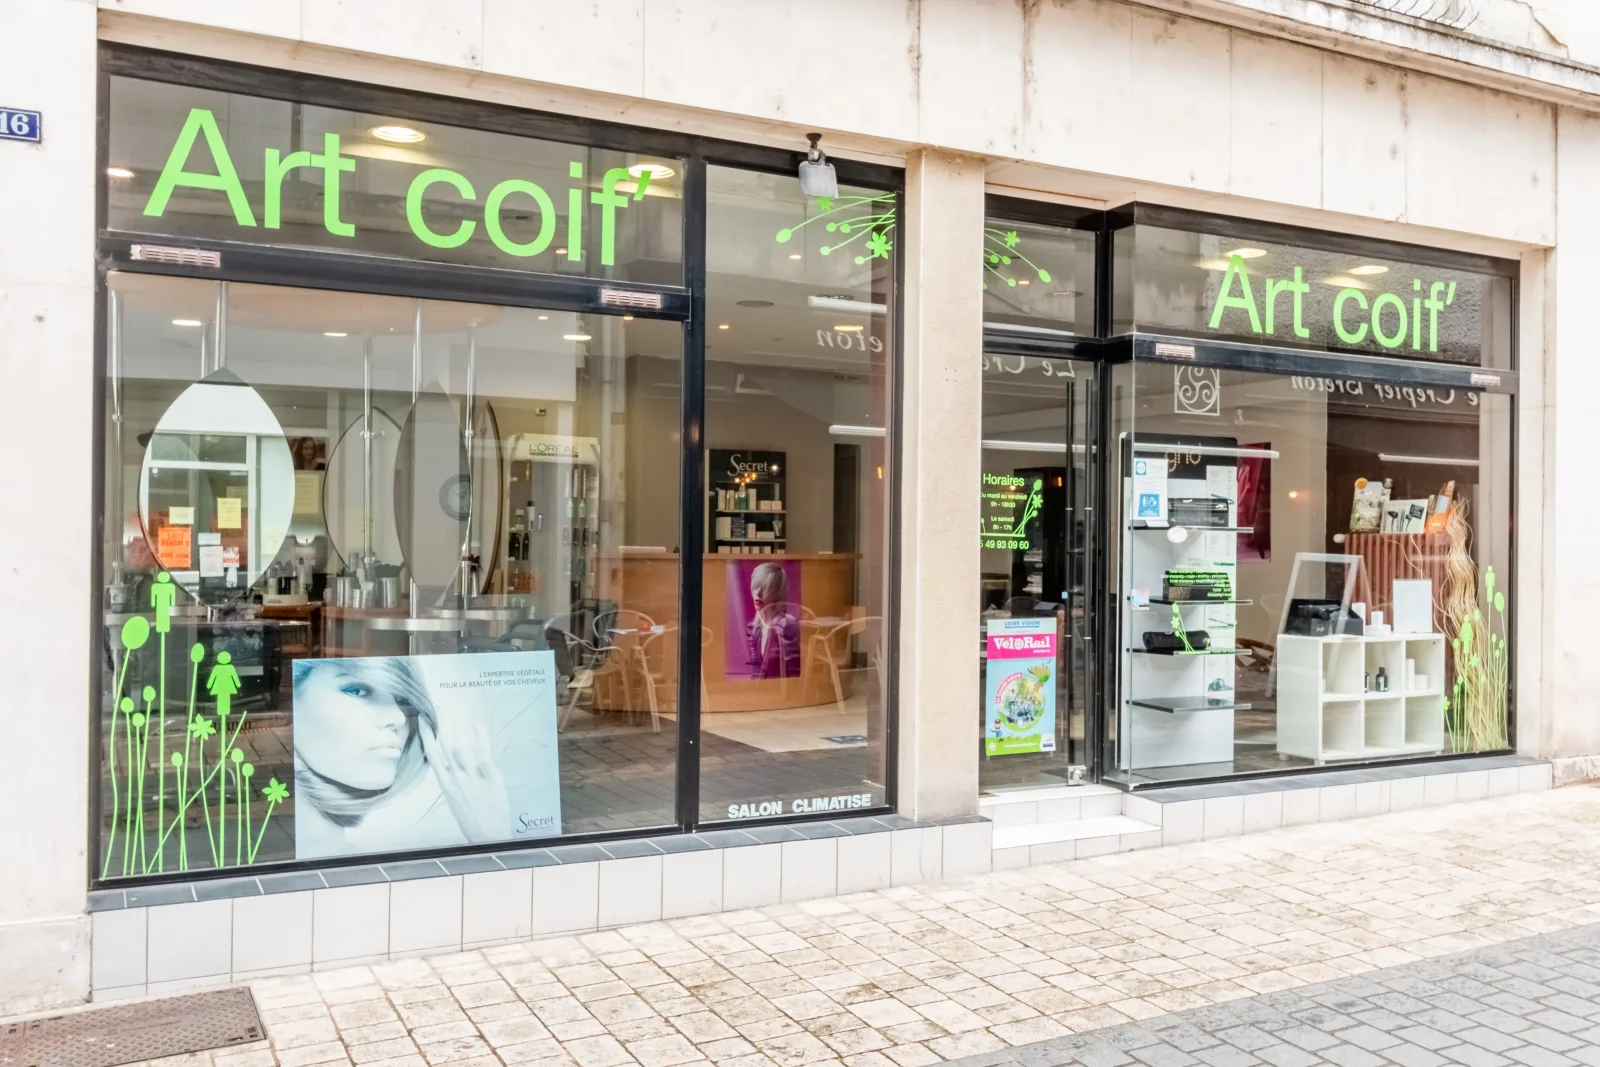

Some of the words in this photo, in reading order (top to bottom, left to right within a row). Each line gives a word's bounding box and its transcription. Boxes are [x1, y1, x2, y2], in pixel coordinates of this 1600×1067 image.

[0, 111, 30, 135] 16
[143, 108, 356, 237] Art
[405, 161, 651, 265] coif'
[1209, 255, 1310, 338] Art
[1333, 279, 1456, 352] coif'
[727, 454, 768, 476] Secret
[983, 473, 1025, 487] Horaires
[985, 540, 995, 548] 49
[997, 540, 1006, 549] 93
[1008, 540, 1018, 549] 09
[1019, 541, 1029, 550] 60
[469, 679, 492, 688] BEAUTÉ
[517, 677, 546, 685] CHEVEUX
[479, 670, 514, 678] L'EXPERTISE
[516, 668, 546, 676] VÉGÉTALE
[728, 801, 782, 818] SALON
[792, 794, 872, 813] CLIMATISE
[516, 812, 554, 833] Secret
